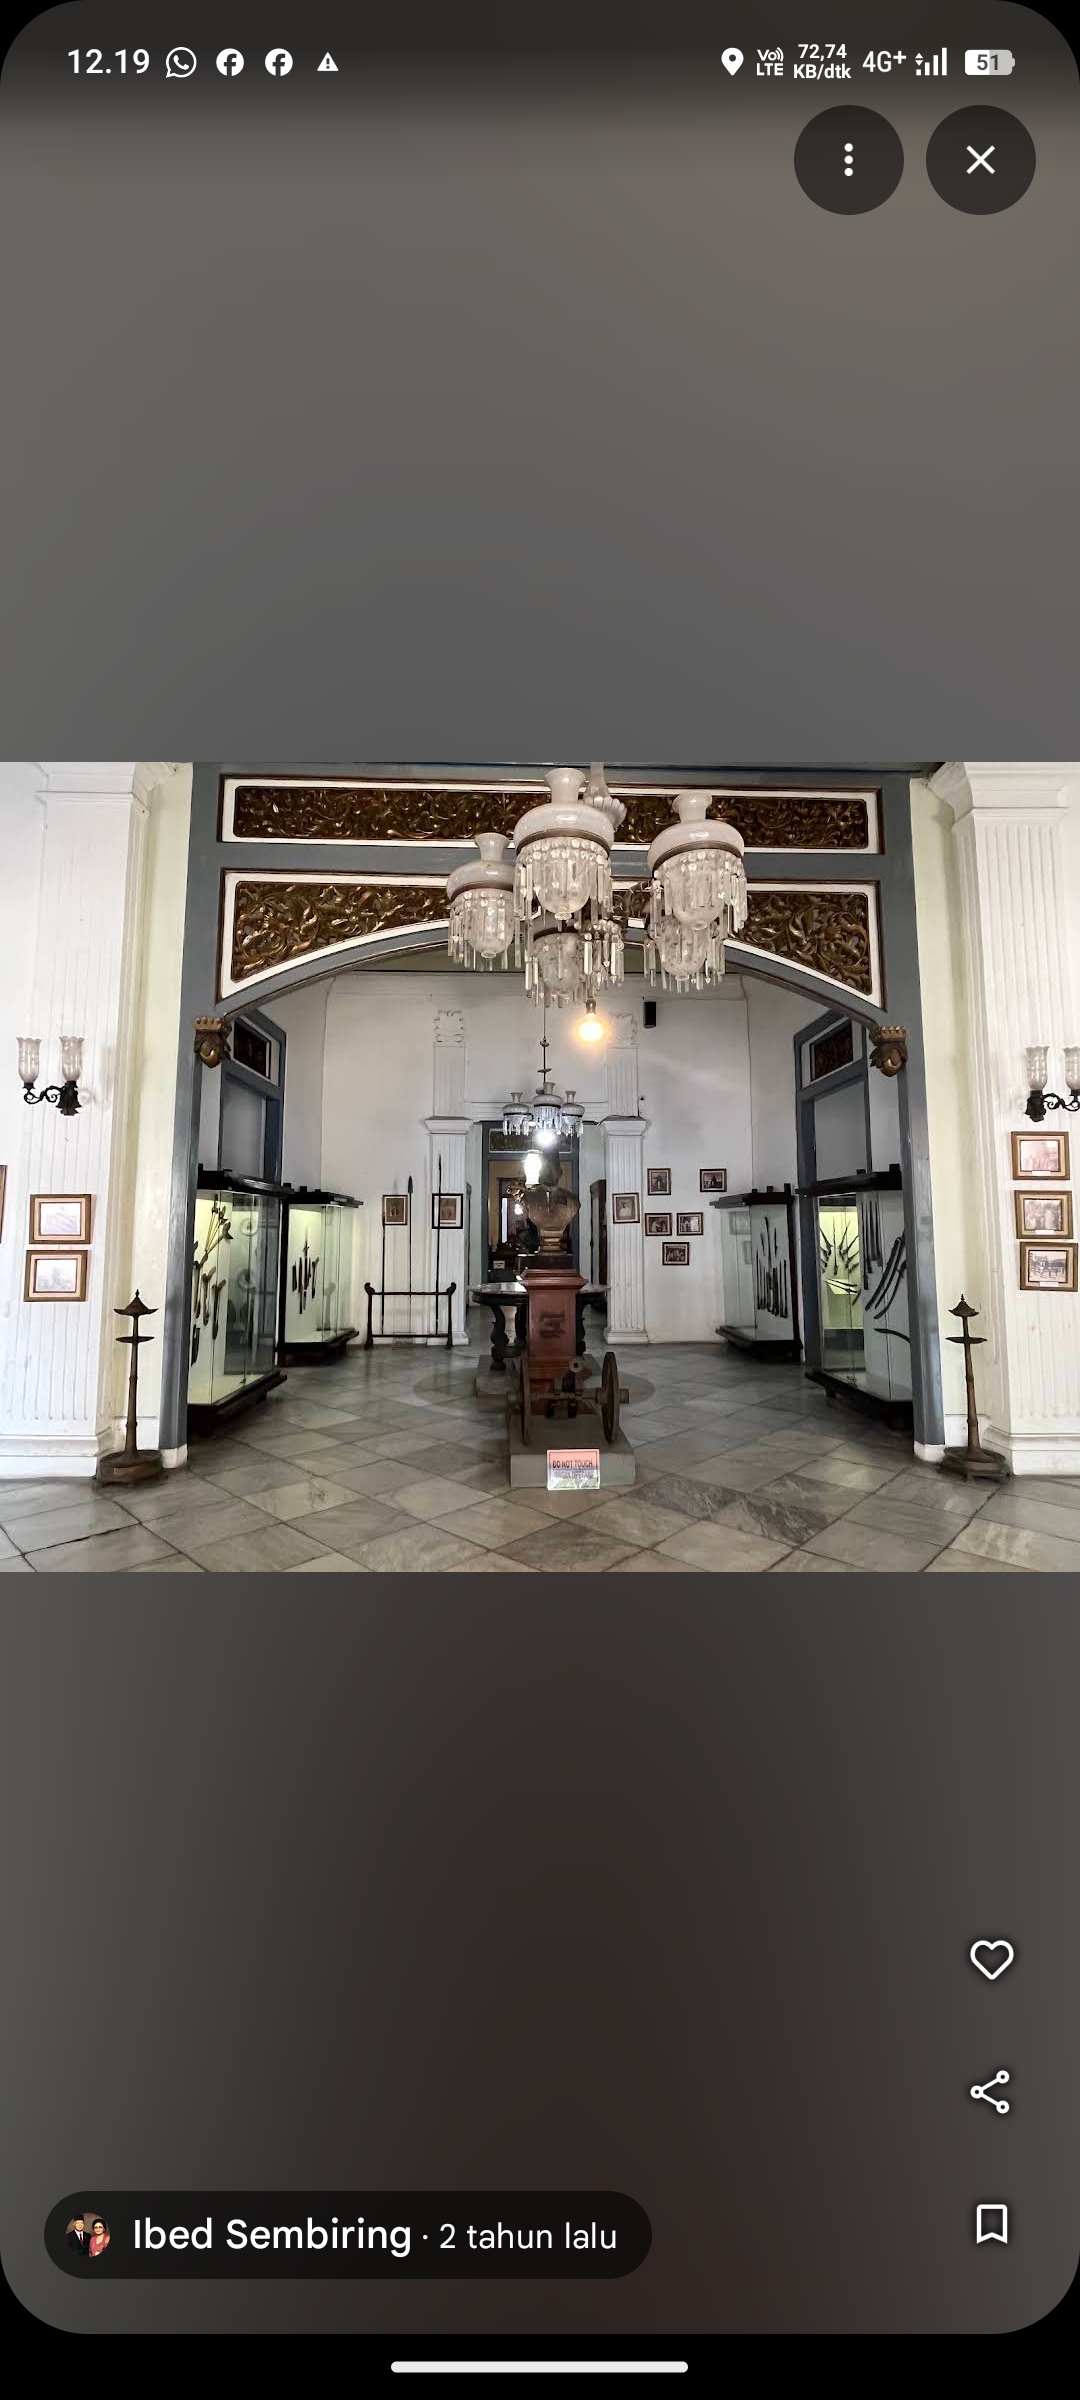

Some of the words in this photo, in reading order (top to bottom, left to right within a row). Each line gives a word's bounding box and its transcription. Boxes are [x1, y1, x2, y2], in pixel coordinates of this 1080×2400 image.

[552, 1460, 561, 1469] DO
[561, 1460, 573, 1469] NOT
[574, 1459, 593, 1468] TOUCH
